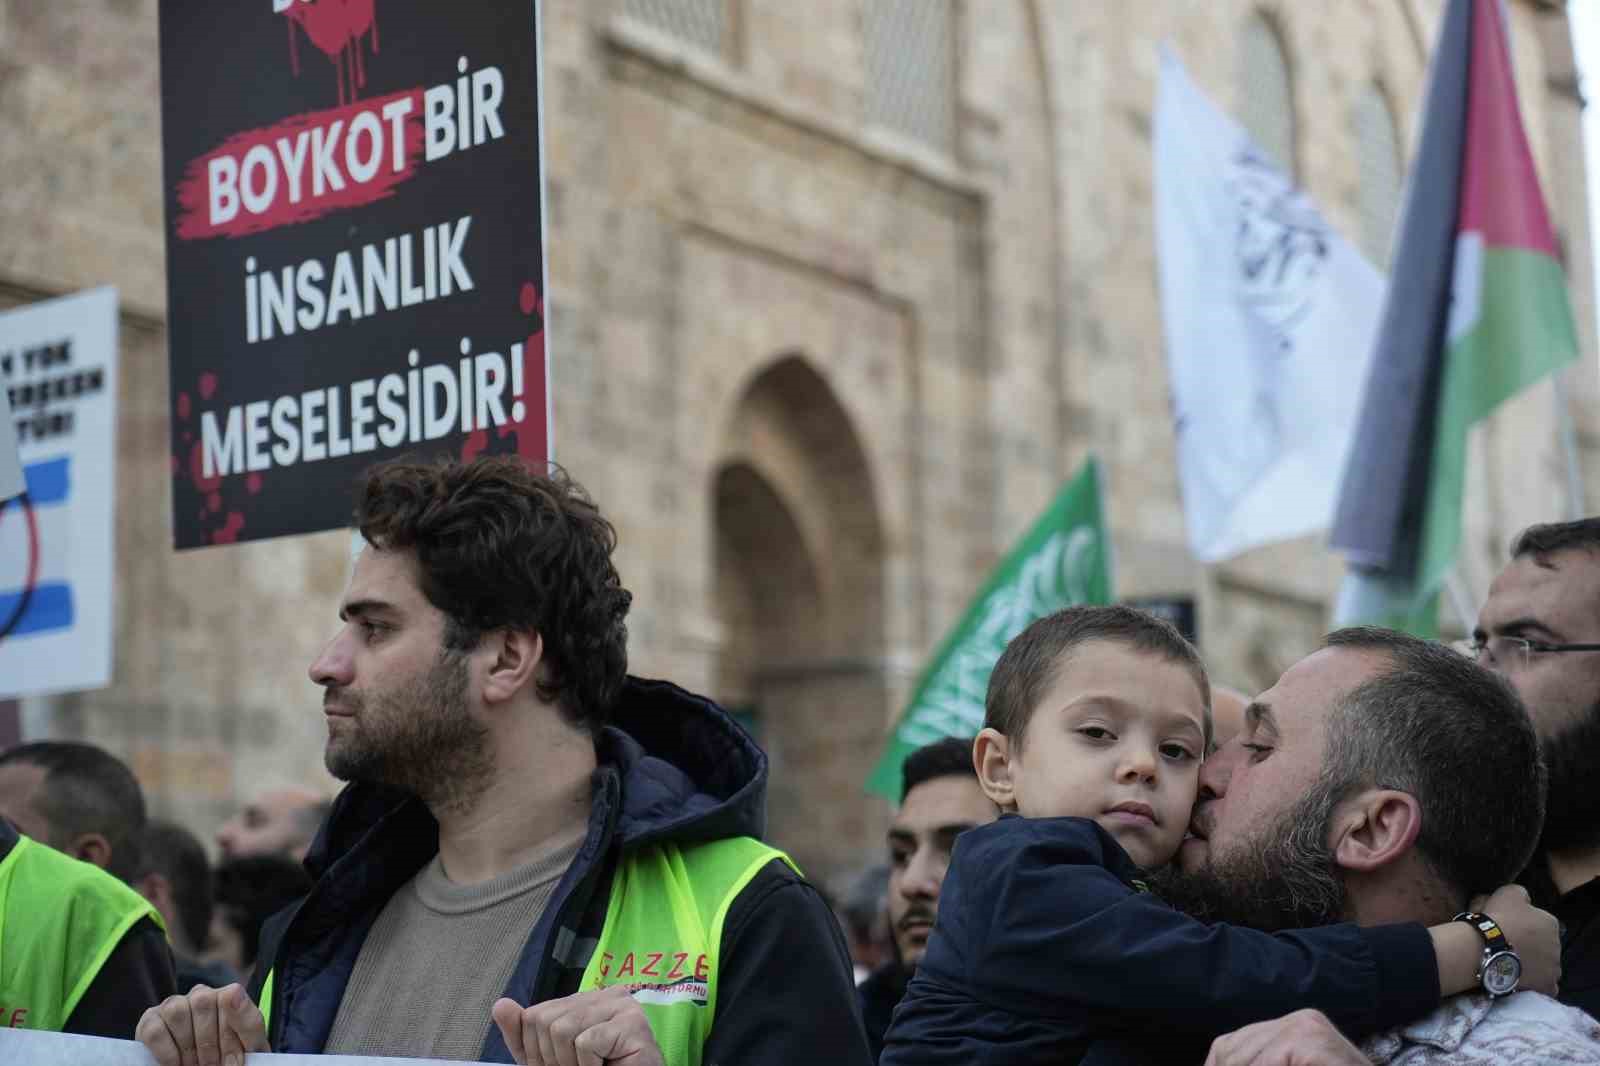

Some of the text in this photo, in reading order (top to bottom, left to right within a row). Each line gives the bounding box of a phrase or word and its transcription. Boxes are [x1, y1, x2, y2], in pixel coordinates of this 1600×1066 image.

[207, 55, 505, 225] BOYKOT BİR
[245, 216, 474, 343] İNSANLIK
[202, 337, 526, 478] MESELESİDİR!
[599, 952, 710, 980] GAZZE
